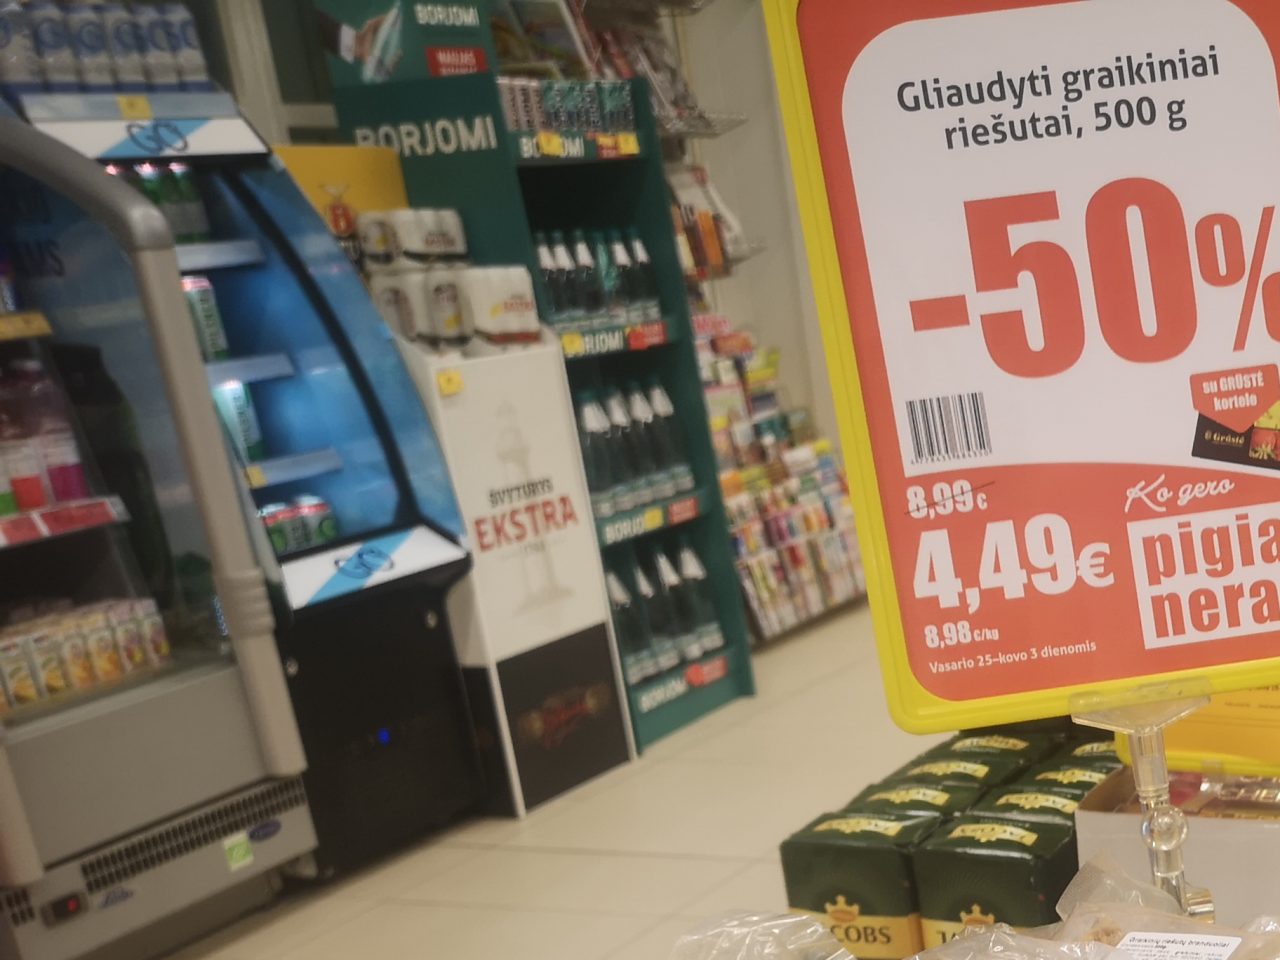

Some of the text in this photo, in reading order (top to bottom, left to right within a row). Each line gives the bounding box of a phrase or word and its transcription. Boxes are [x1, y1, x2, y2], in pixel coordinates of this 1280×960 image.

[897, 46, 1220, 113] Gliaudyti graikiniai
[944, 98, 1188, 150] riešutai, 500 g
[1203, 380, 1218, 393] su
[1125, 475, 1235, 512] Ko gero
[474, 496, 578, 553] EKSTRA
[913, 513, 1115, 614] 4,49€
[929, 656, 974, 673] Vasario
[1030, 647, 1038, 659] 3
[1041, 640, 1096, 657] dienomis
[830, 924, 891, 944] COBS
